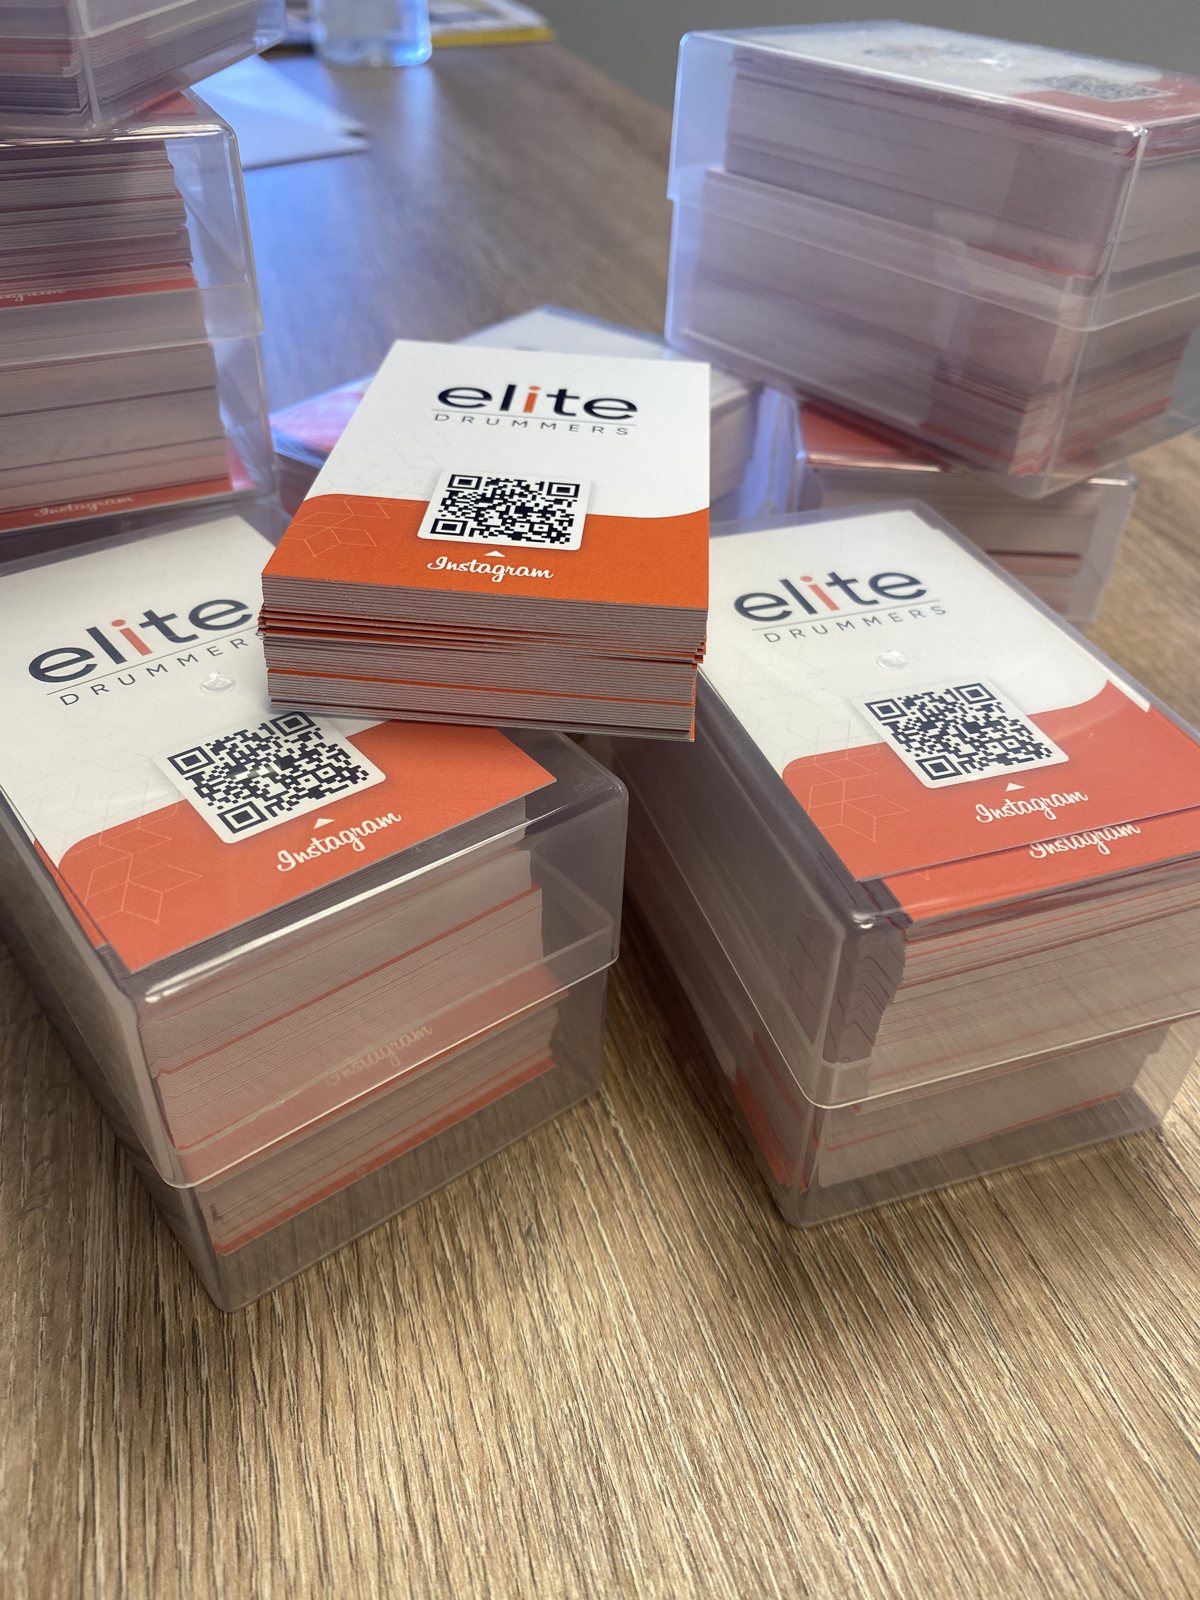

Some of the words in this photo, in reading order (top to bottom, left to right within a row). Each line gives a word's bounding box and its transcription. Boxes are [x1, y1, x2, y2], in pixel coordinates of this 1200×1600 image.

[438, 384, 638, 420] elite
[434, 413, 629, 436] DRUMMERS
[427, 556, 554, 583] Instagram
[733, 571, 927, 622] elite
[28, 599, 253, 683] elite
[763, 605, 947, 643] DRUMMERS
[975, 791, 1089, 823] Instagram
[277, 812, 402, 872] Instagram
